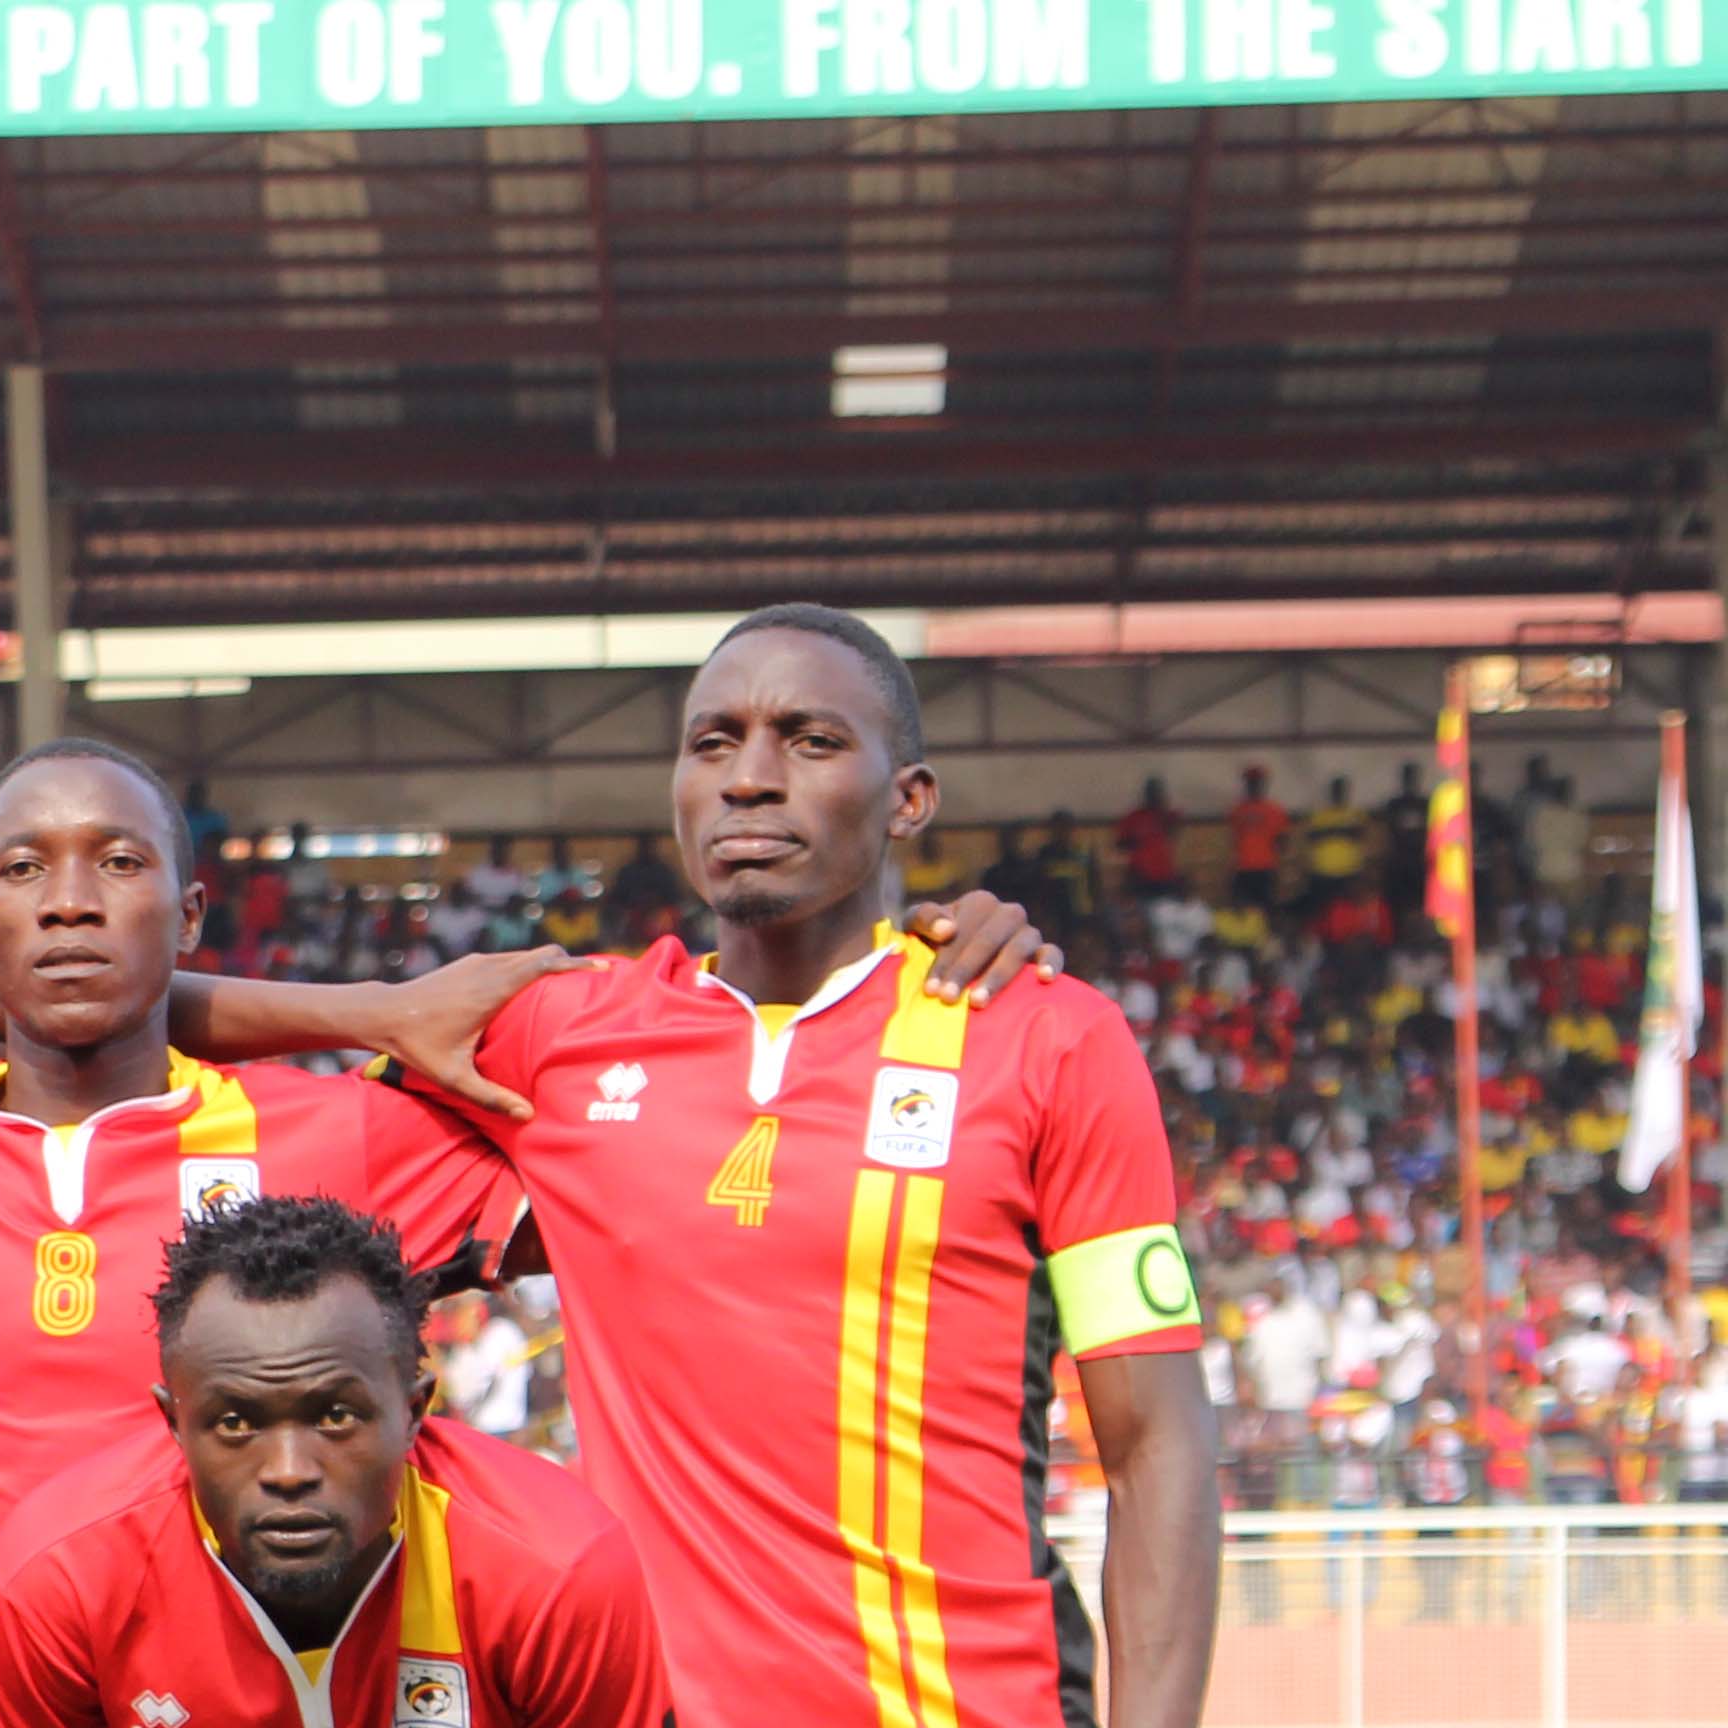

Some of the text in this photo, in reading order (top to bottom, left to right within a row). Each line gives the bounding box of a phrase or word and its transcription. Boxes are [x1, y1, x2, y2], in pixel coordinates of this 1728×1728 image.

[7, 0, 1704, 113] PART OF YOU. FROM THE START
[706, 1116, 780, 1227] 4
[32, 1231, 96, 1336] 8
[1135, 1239, 1191, 1317] C
